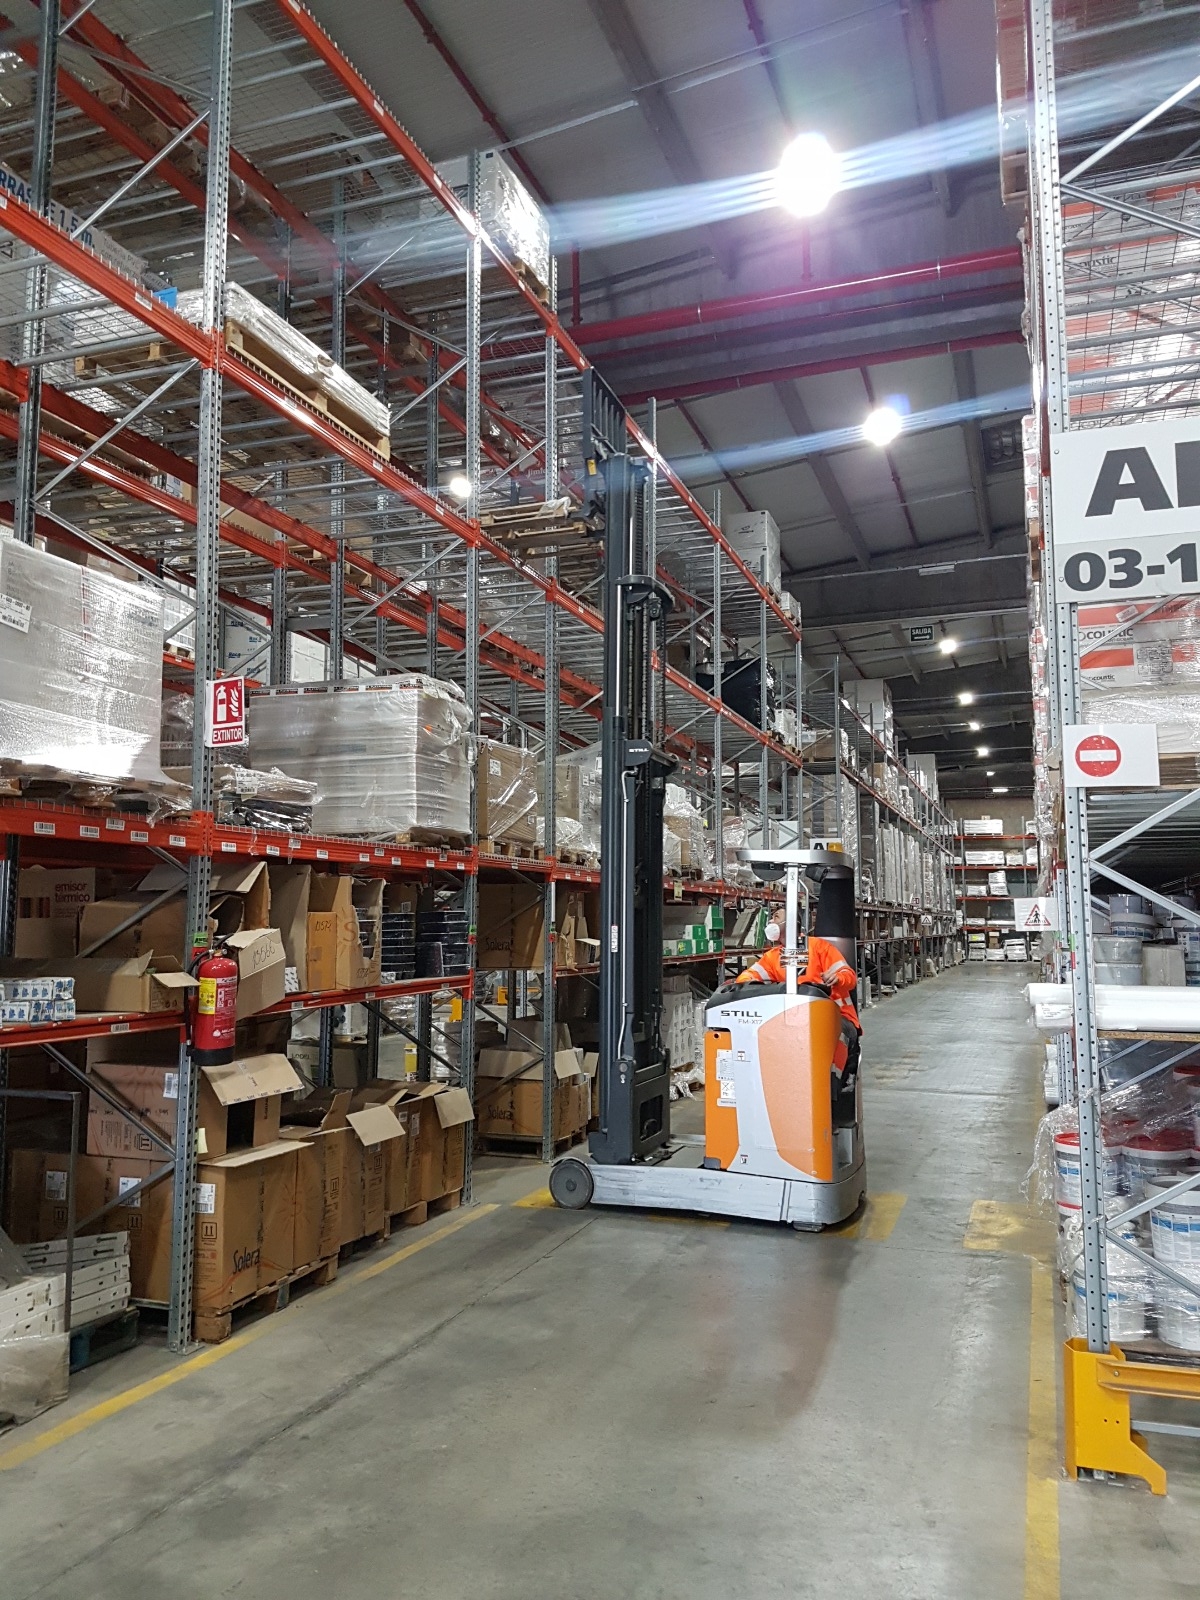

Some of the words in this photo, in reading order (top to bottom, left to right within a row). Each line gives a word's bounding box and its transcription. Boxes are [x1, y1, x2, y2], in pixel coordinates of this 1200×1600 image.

[912, 627, 932, 635] SALIDA
[213, 728, 243, 741] EXTINTOR
[55, 881, 88, 891] emisor
[232, 1246, 261, 1275] Solera
